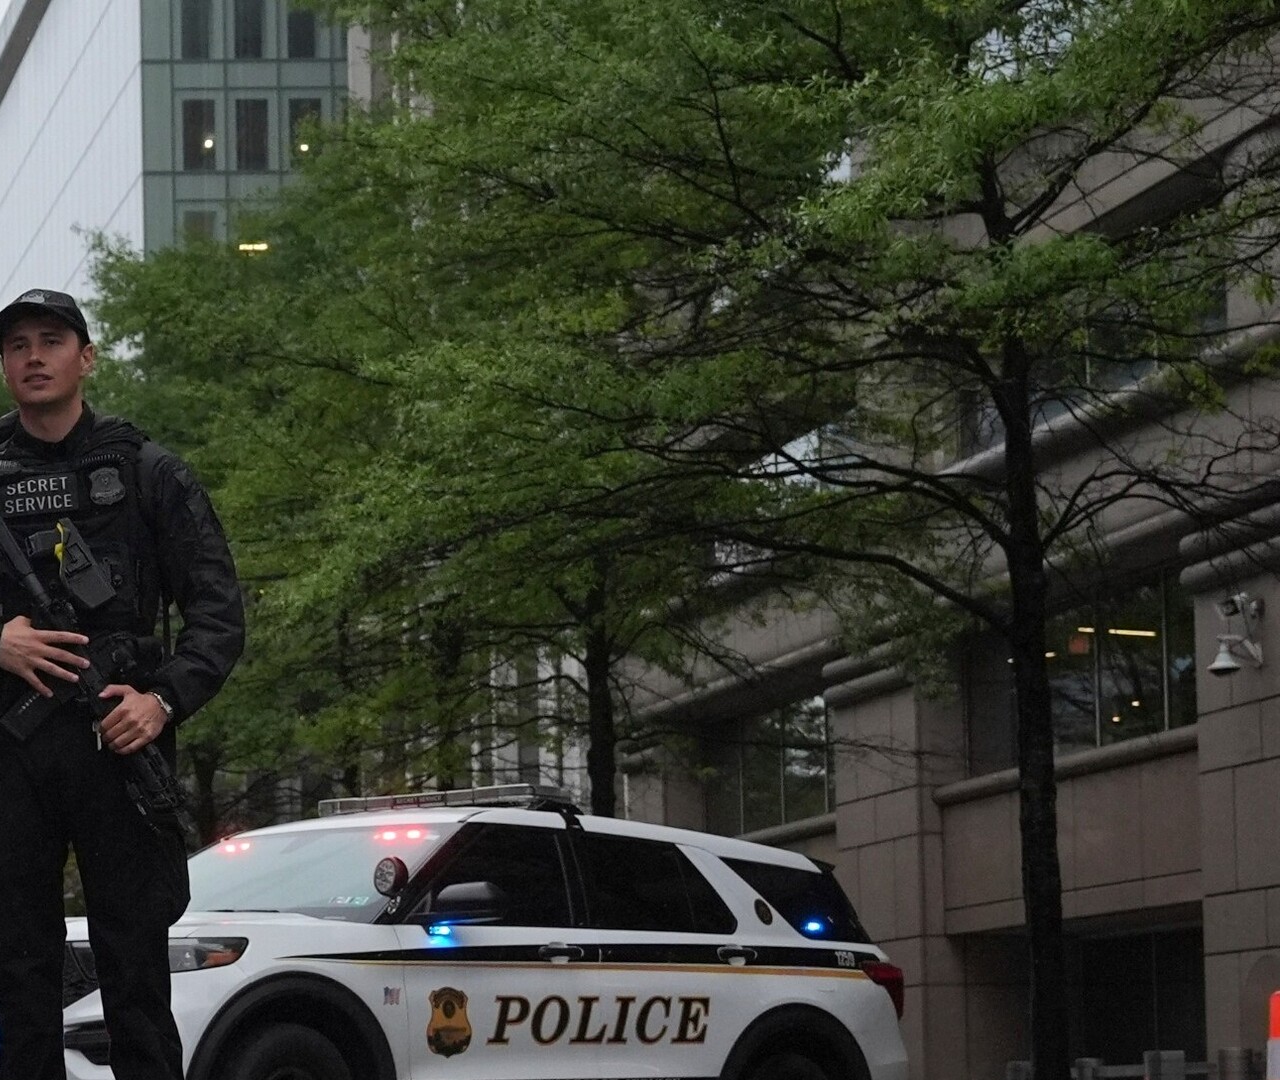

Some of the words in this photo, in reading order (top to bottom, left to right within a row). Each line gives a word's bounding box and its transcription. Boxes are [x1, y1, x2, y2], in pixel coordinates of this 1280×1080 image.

[6, 476, 68, 496] SECRET
[4, 493, 73, 514] SERVICE
[486, 994, 711, 1046] POLICE
